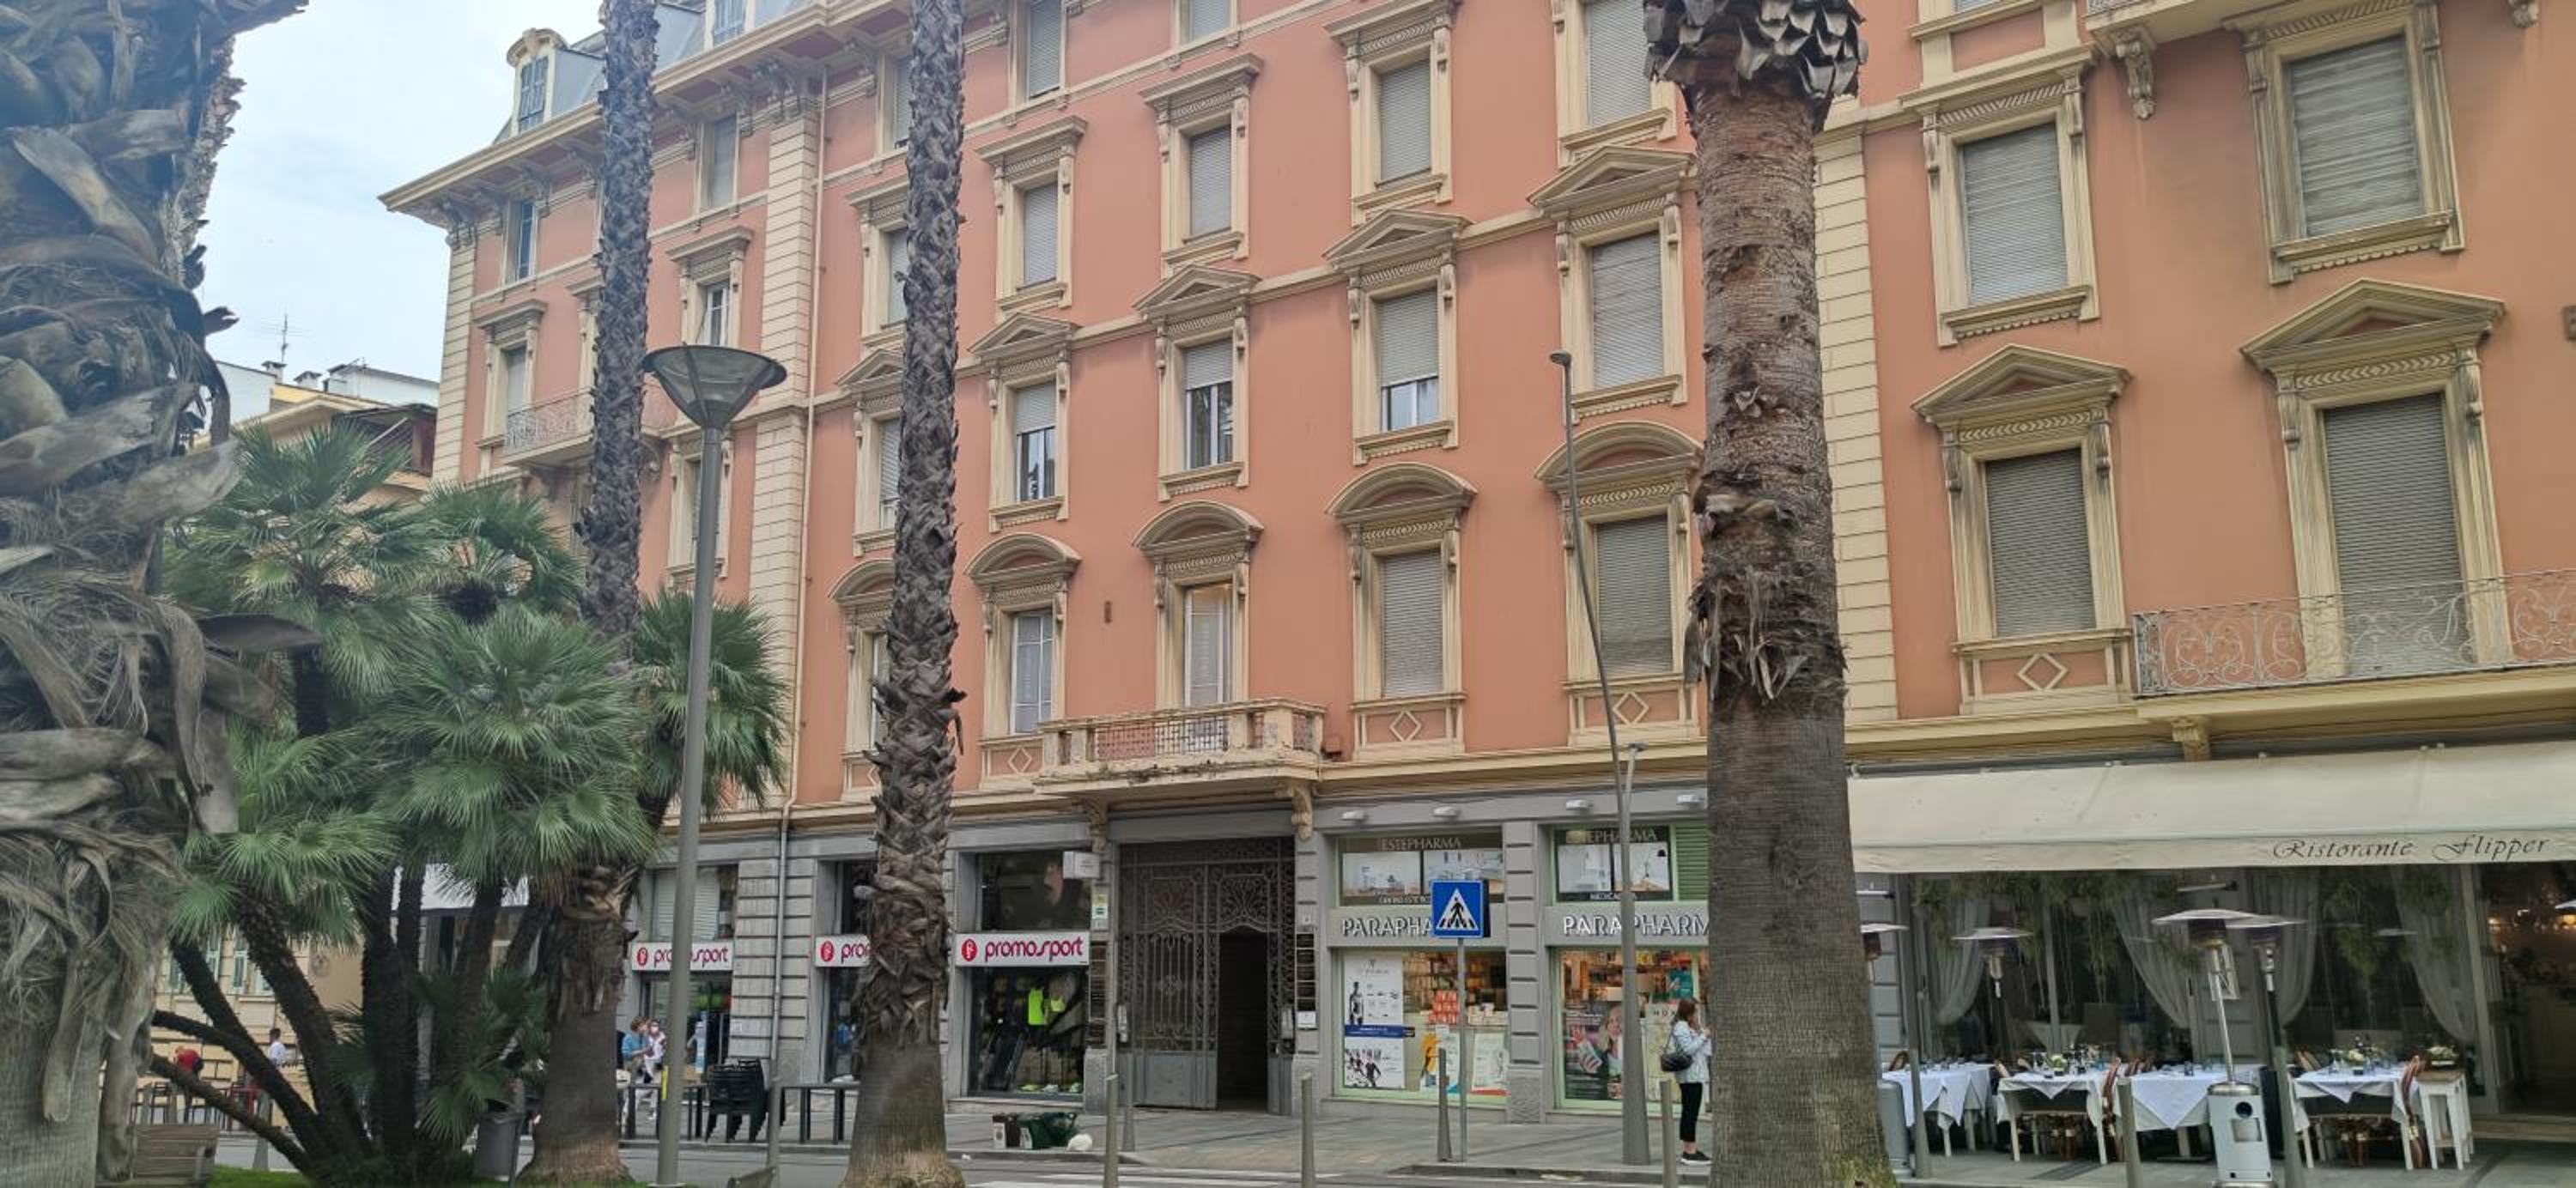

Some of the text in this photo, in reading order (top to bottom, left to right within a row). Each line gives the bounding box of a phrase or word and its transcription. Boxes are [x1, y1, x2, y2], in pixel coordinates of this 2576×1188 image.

[2273, 833, 2549, 863] Ristorante Flipper
[1342, 916, 1433, 936] PARAPHA
[1563, 914, 1710, 936] PARAPHARM
[984, 936, 1084, 961] promosport
